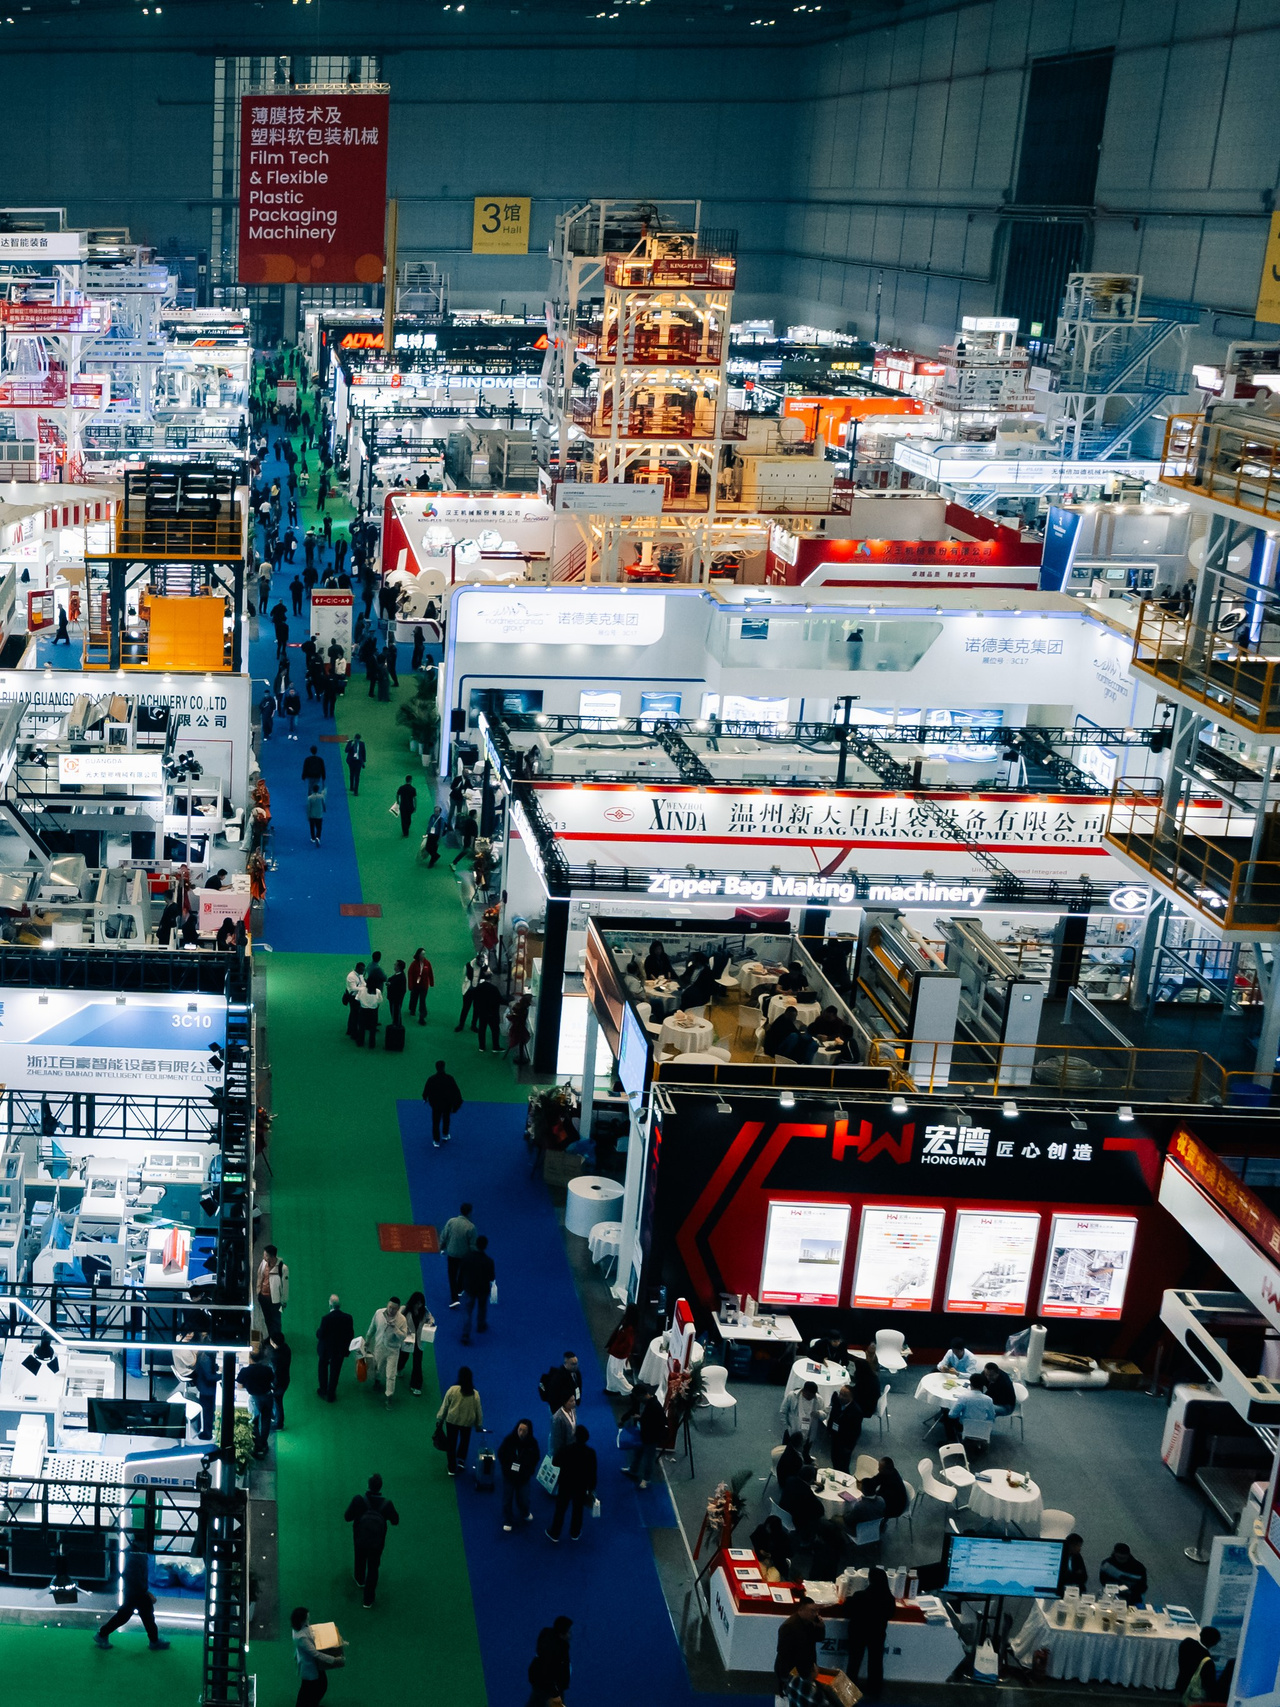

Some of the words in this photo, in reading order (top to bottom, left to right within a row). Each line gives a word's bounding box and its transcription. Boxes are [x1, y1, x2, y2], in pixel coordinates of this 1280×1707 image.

[251, 106, 342, 125] 薄膜技术及
[250, 127, 379, 146] 塑料软包装机械
[250, 150, 284, 164] Film
[289, 150, 329, 164] Tech
[249, 171, 262, 184] &
[267, 170, 328, 184] Flexible
[249, 191, 304, 204] Plastic
[249, 208, 338, 226] Packaging
[248, 225, 336, 243] Machinery
[503, 225, 522, 234] Hall
[558, 611, 639, 626] 诺德美克集团
[503, 624, 525, 633] group
[964, 636, 1063, 656] 诺德美克集团
[666, 801, 705, 811] WENZHOU
[648, 798, 707, 832] XINDA
[728, 824, 758, 834] ZIP
[761, 824, 809, 835] LOCK
[813, 826, 847, 837] BAG
[851, 827, 924, 838] MAKING
[648, 875, 721, 899] Zipper
[724, 876, 766, 900] Bag
[772, 879, 855, 902] Making
[869, 882, 987, 907] machinery
[171, 1014, 212, 1029] 3C10
[27, 1069, 63, 1077] ZHEJIANG
[145, 1073, 189, 1082] EQUIPMENT
[922, 1125, 991, 1156] 宏湾
[996, 1140, 1093, 1161] 匠心创造
[921, 1156, 986, 1166] HONGWAN
